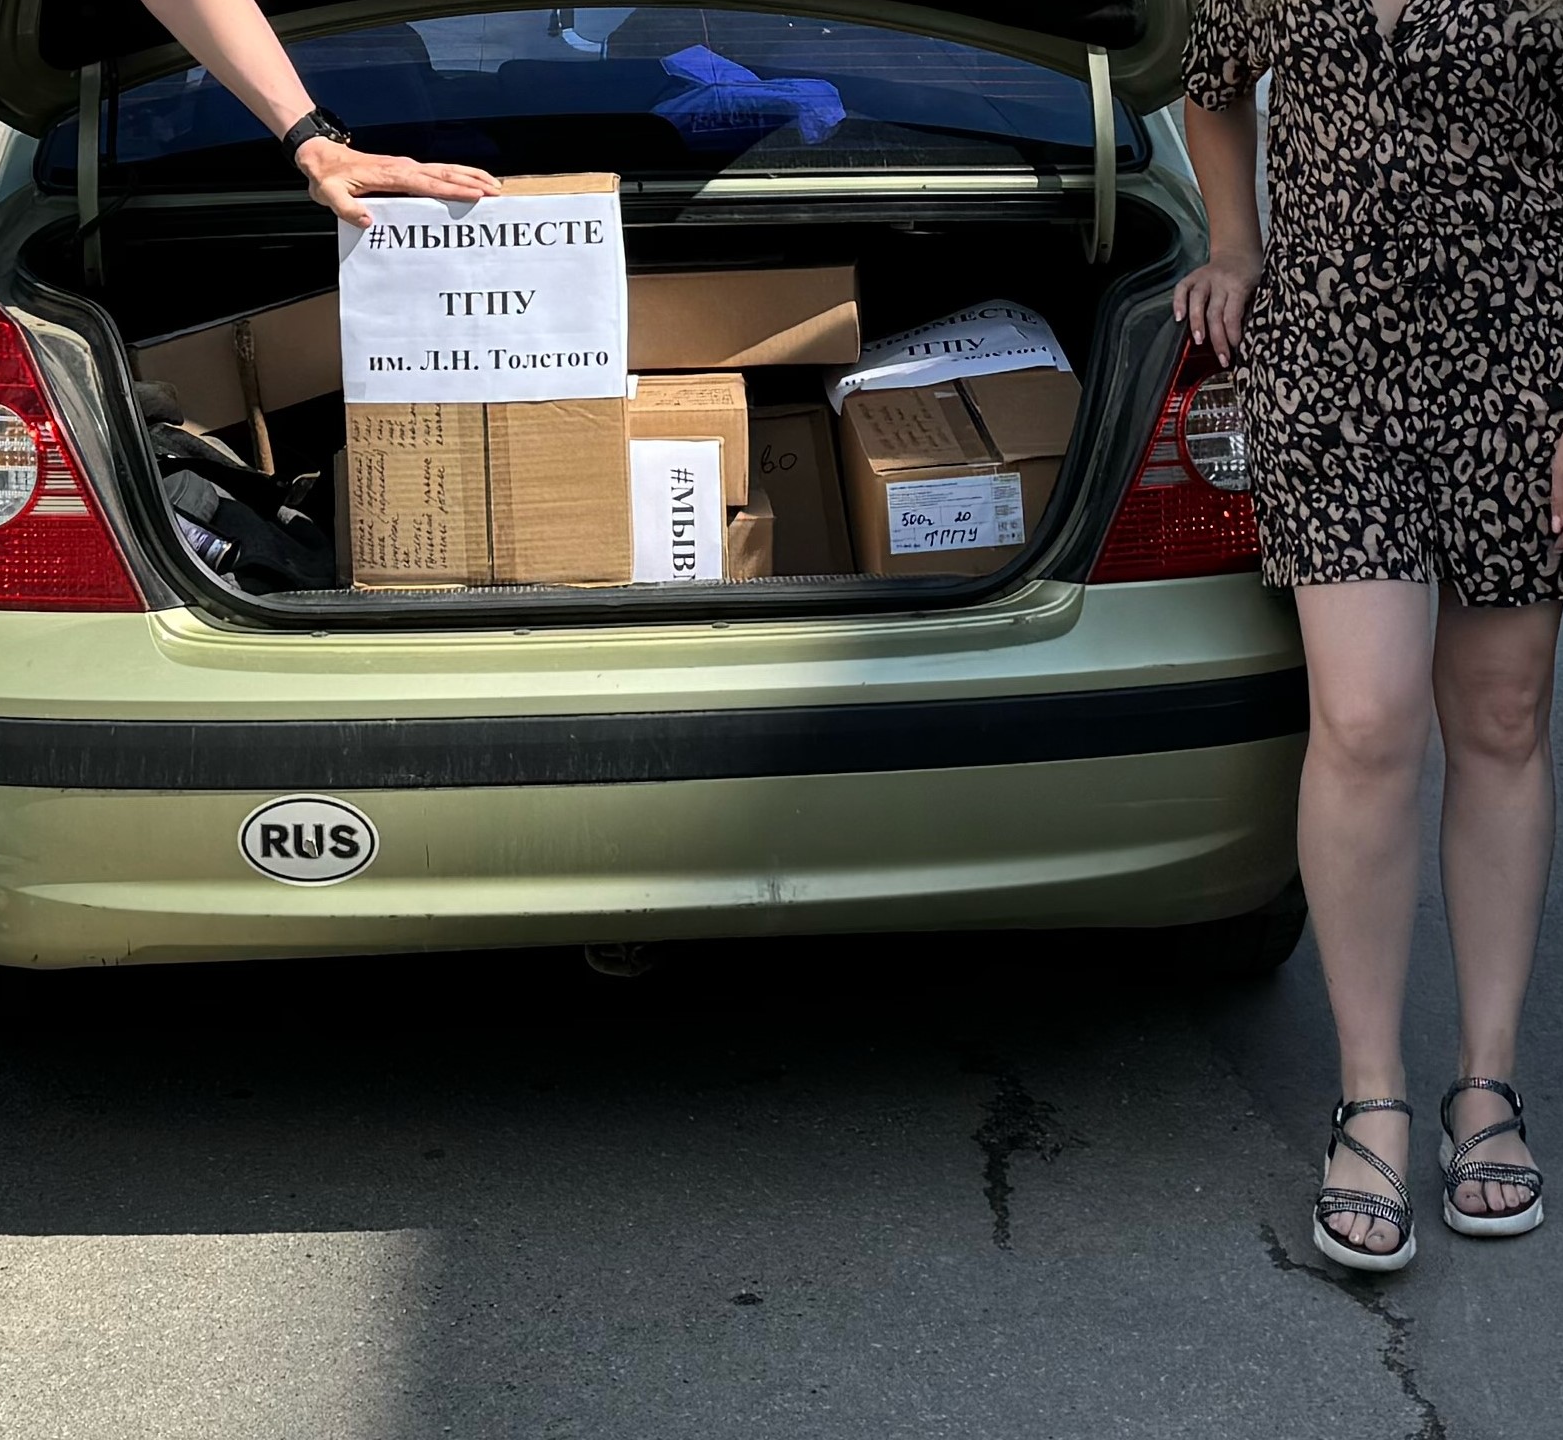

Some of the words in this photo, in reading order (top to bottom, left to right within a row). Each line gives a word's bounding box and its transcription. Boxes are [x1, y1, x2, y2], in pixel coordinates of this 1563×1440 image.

[368, 220, 604, 250] #МЫВМЕСТЕ
[439, 289, 536, 316] ТГПУ
[902, 337, 986, 356] ТГПУ
[369, 356, 412, 371] им.
[420, 350, 480, 371] Л.Н.
[488, 349, 609, 370] Толстого
[670, 468, 696, 580] #МЫВ
[954, 511, 972, 522] 20
